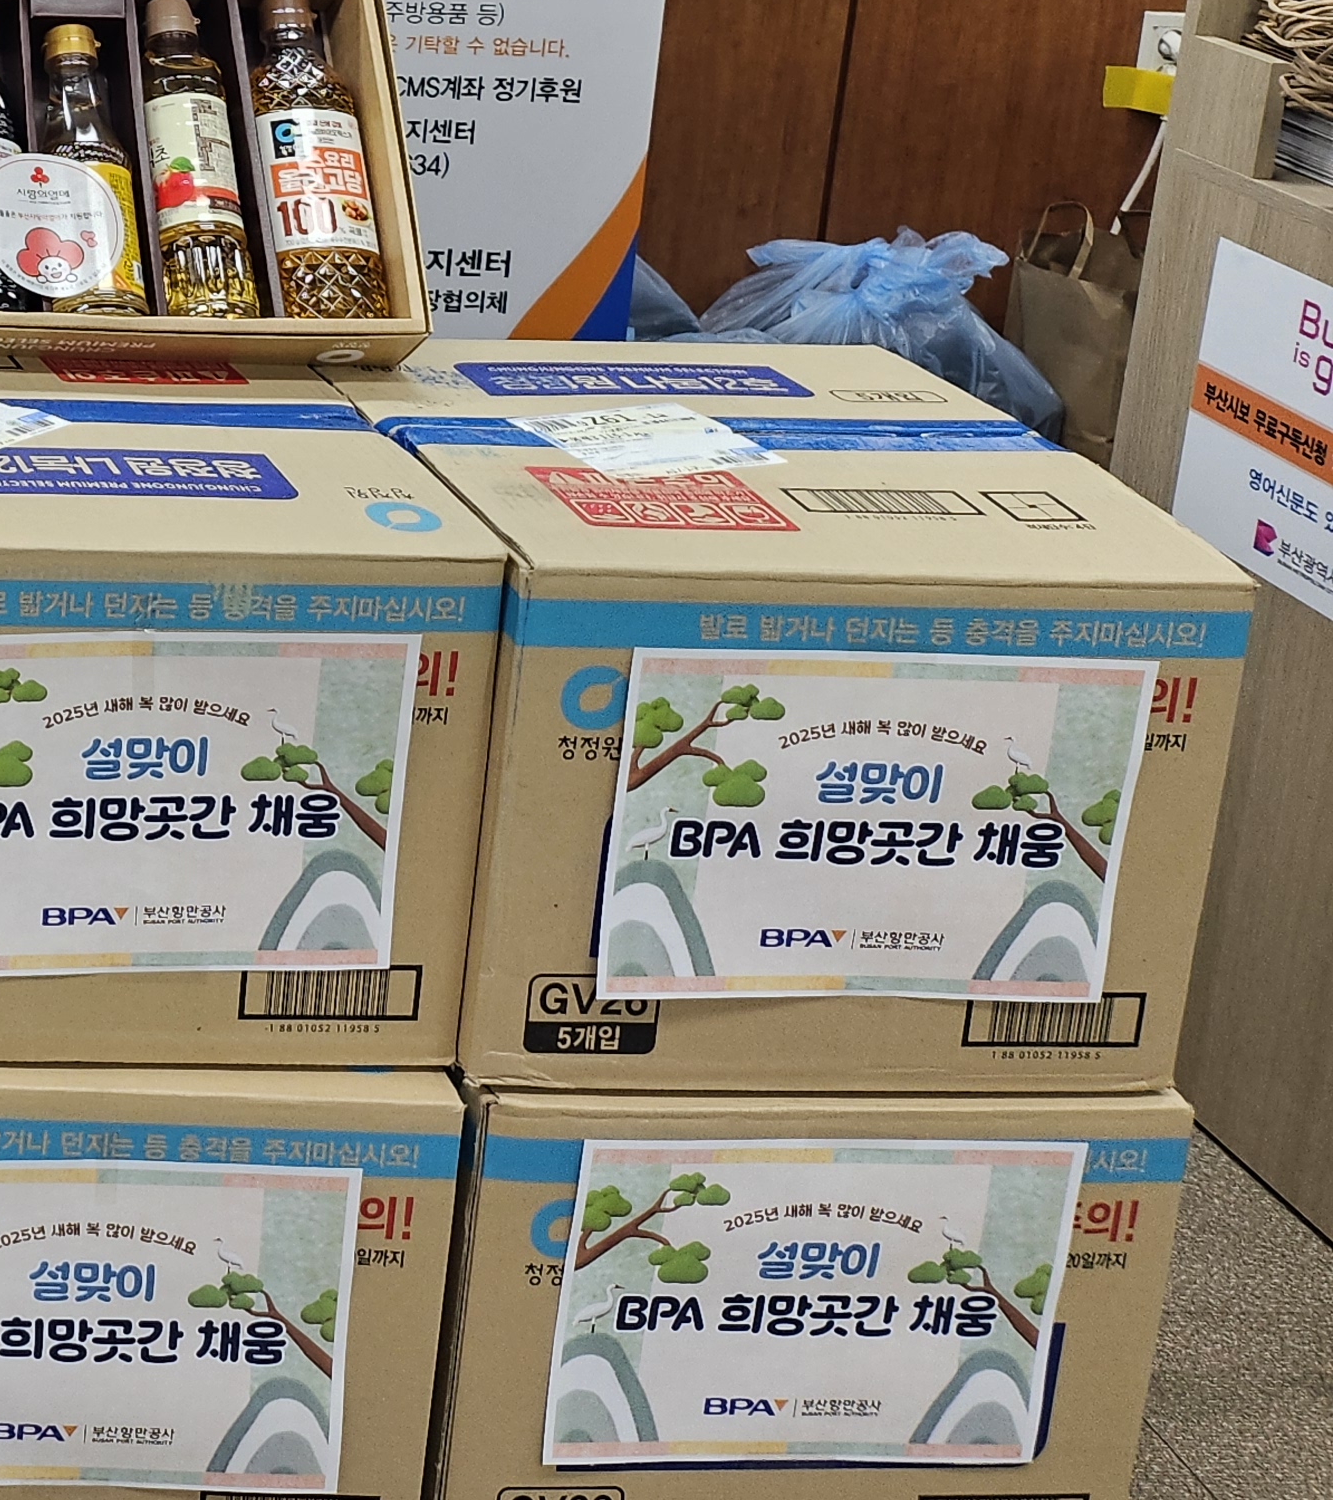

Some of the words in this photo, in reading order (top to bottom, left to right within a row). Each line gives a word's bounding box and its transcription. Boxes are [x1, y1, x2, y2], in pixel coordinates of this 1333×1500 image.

[385, 1, 468, 26] 주방용품
[476, 3, 505, 26] 등)
[405, 35, 460, 55] 기탁할
[466, 37, 485, 54] 수
[492, 37, 570, 59] 없습니다.
[396, 75, 484, 102] CMS계좌
[493, 78, 583, 104] 정기후원
[1293, 342, 1311, 369] is
[1203, 382, 1251, 425] 부산시보
[1253, 409, 1329, 468] 무료구독신청
[1249, 468, 1319, 524] 영어신문도
[814, 760, 945, 807] 설맞이
[669, 820, 763, 861] BPA
[774, 818, 964, 869] 희망곳간
[976, 821, 1065, 869] 채움
[757, 1240, 880, 1281] 설맞이
